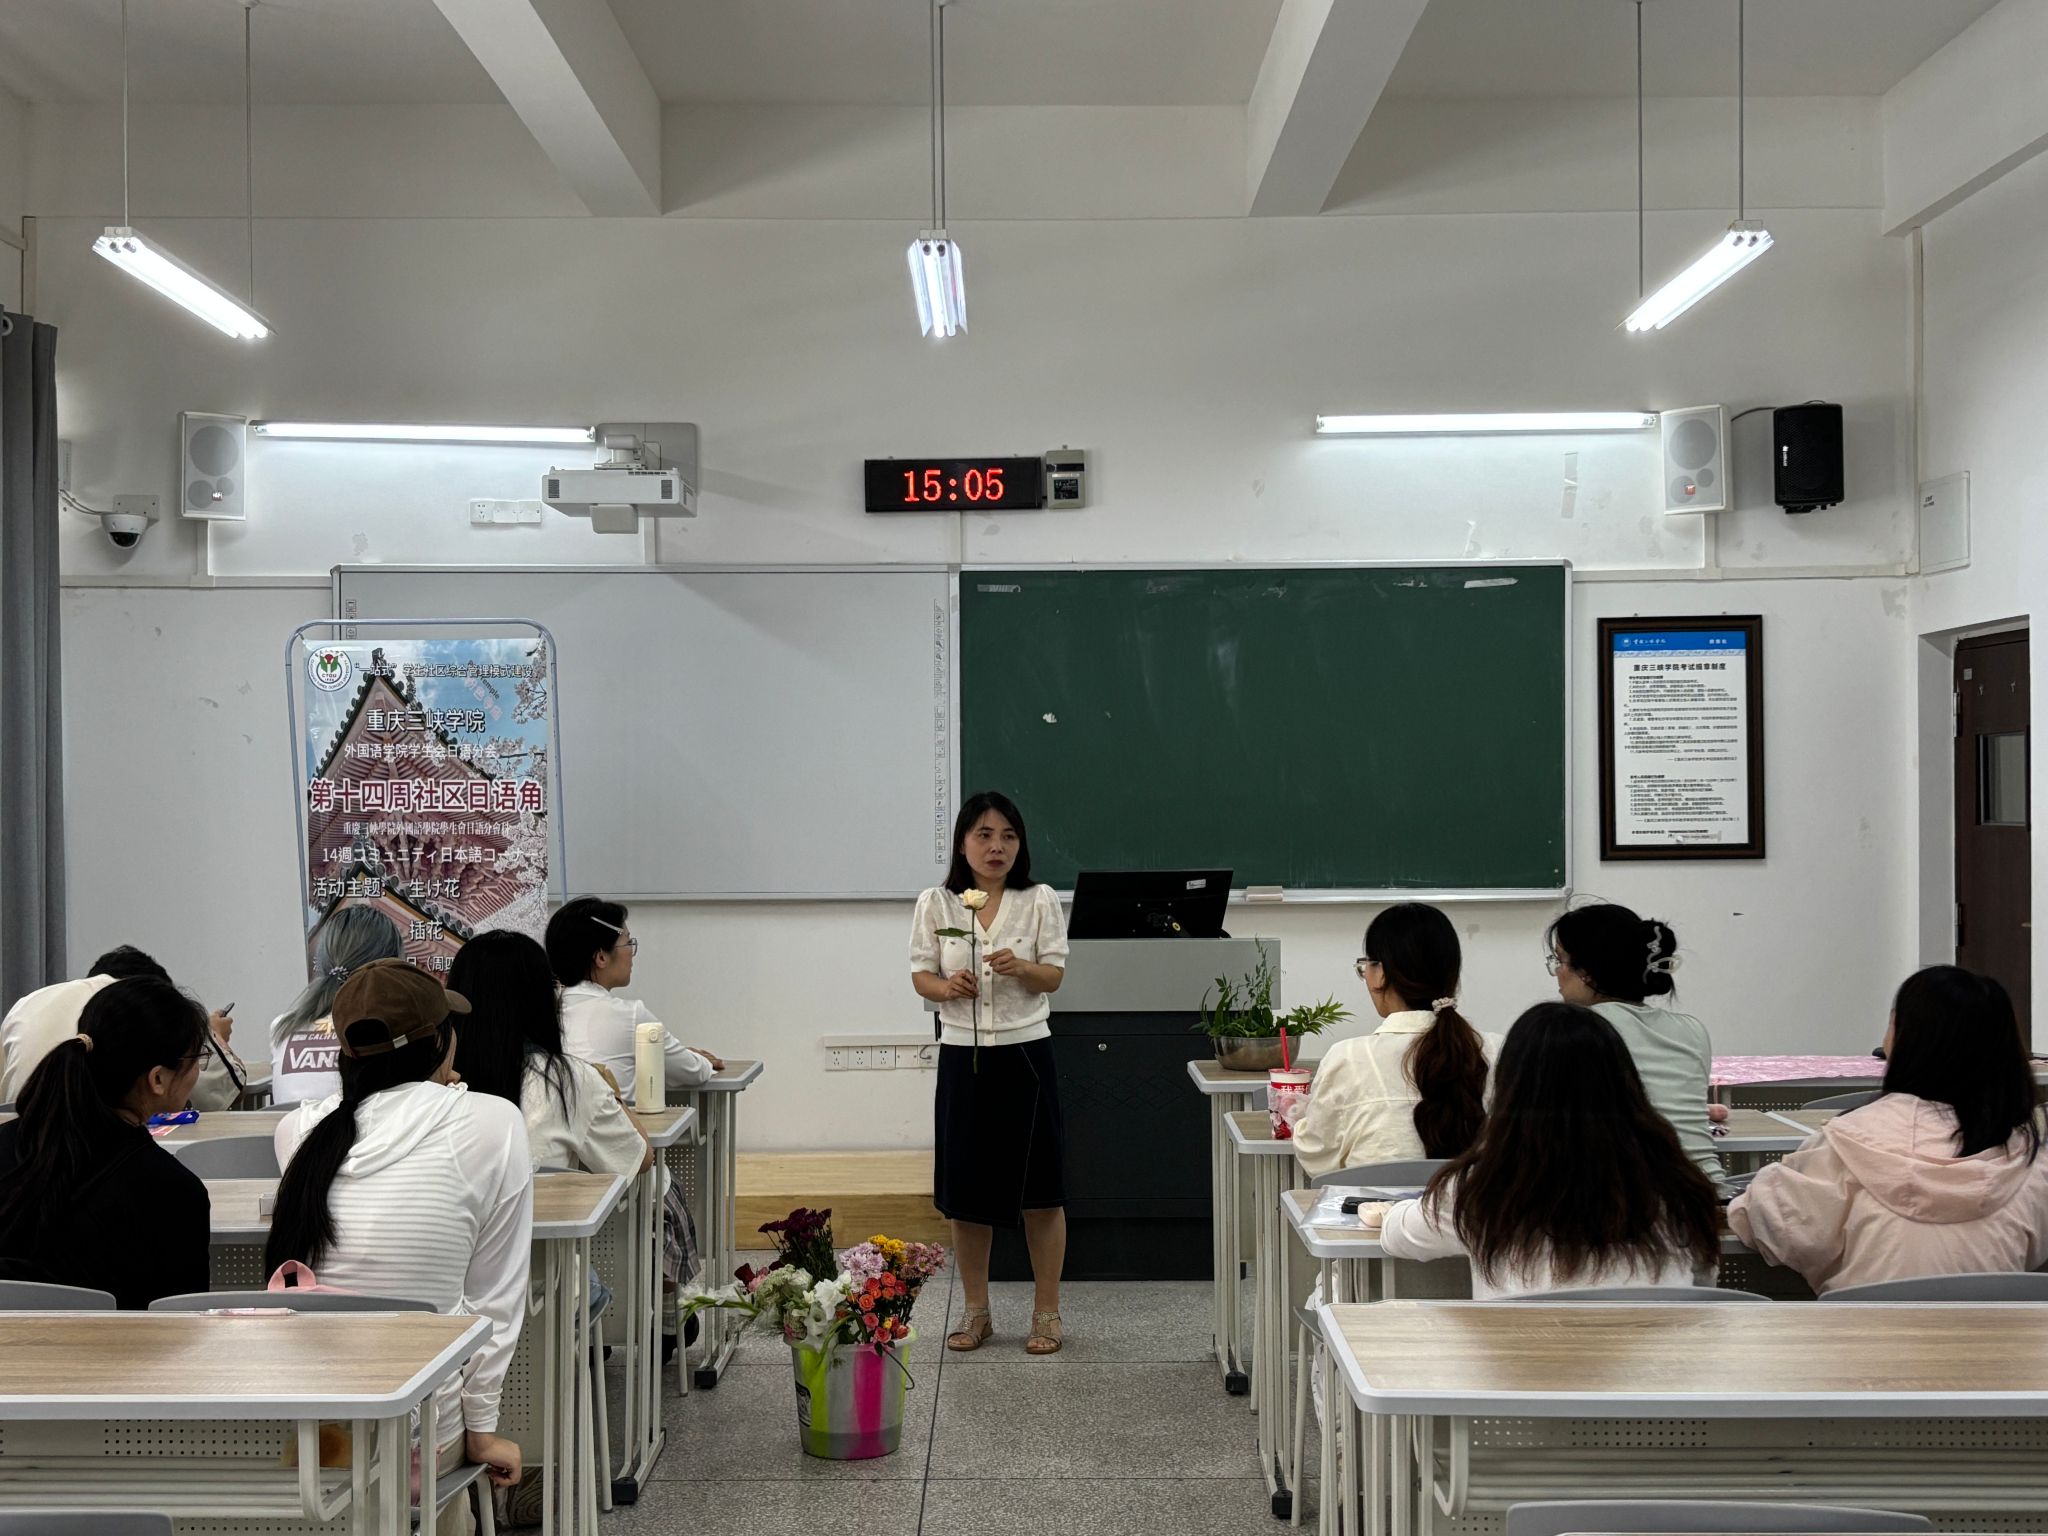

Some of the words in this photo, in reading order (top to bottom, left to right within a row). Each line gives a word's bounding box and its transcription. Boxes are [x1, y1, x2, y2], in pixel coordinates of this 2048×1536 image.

[904, 468, 1004, 501] 15:05
[366, 709, 486, 733] 重庆三峡学院
[344, 743, 498, 759] 外国语学院学生会日语分会
[310, 778, 543, 814] 第十四周社区日语角
[409, 878, 461, 899] 生け花
[409, 920, 444, 941] 插花
